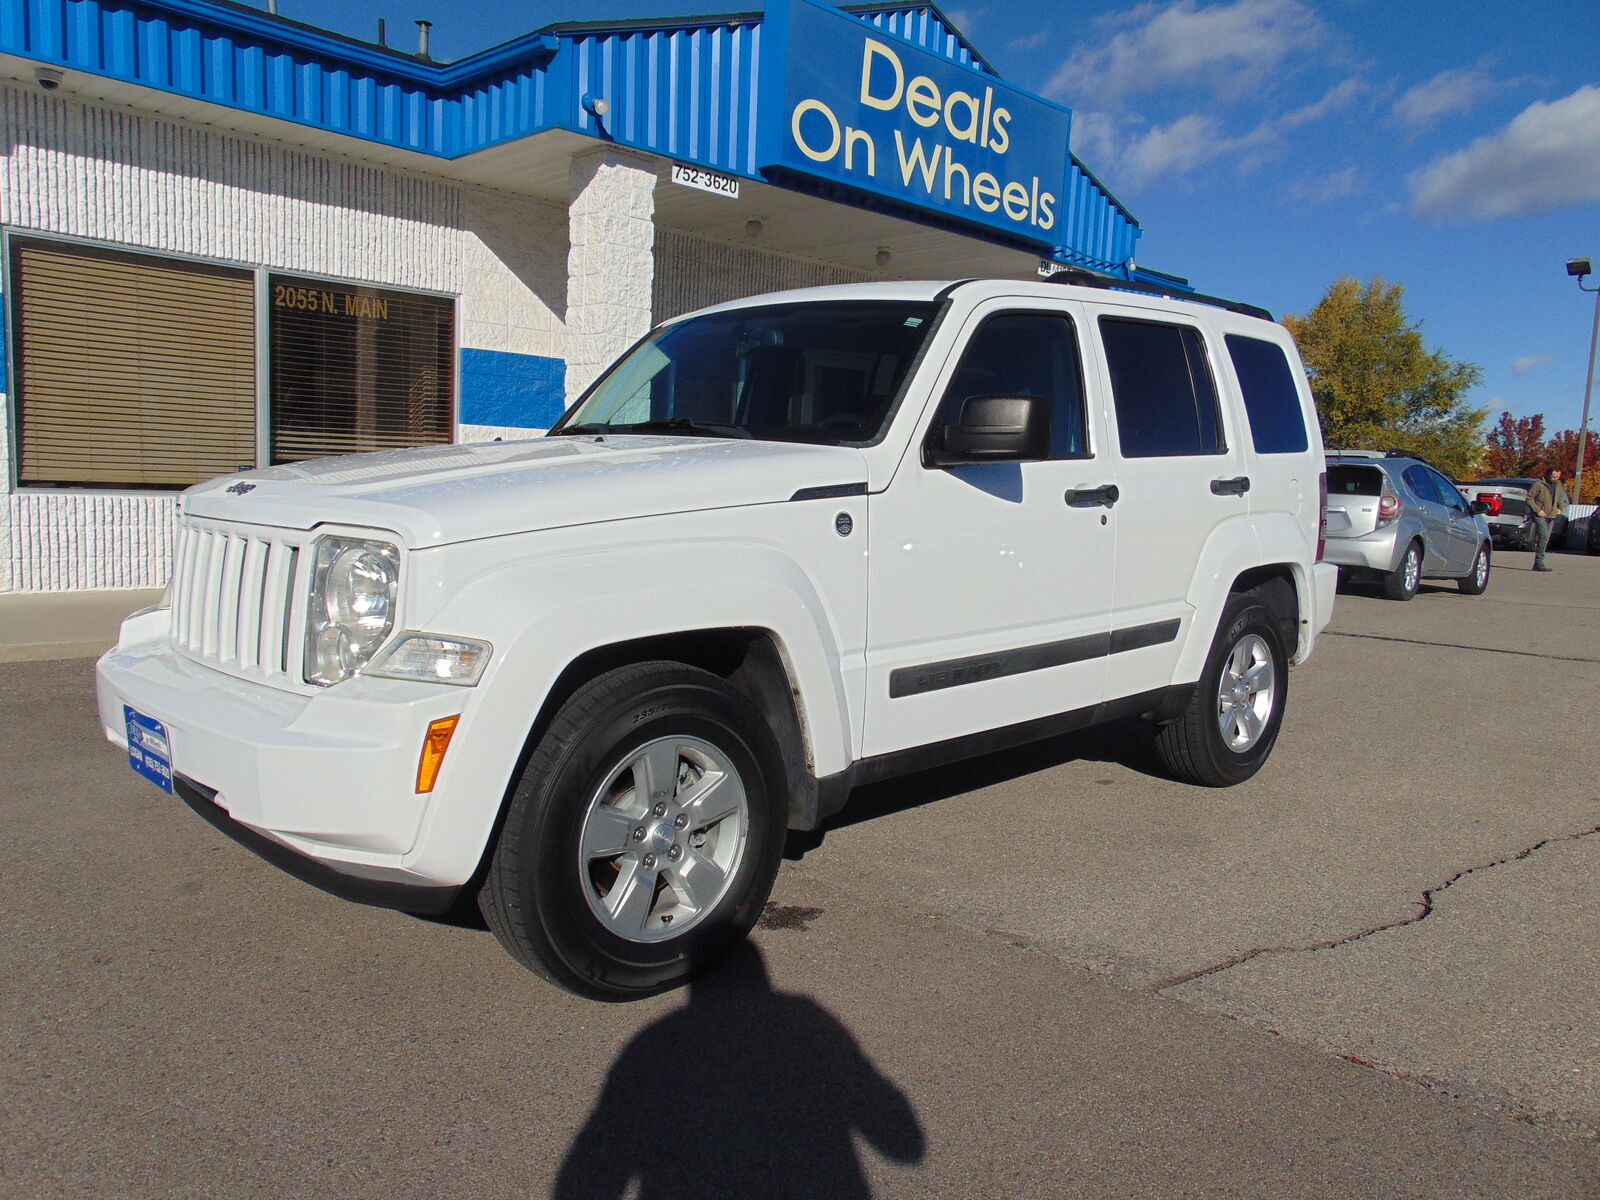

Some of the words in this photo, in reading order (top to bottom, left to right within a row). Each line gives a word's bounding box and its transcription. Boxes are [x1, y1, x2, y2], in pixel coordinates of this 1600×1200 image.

[860, 37, 1012, 154] Deals
[674, 163, 737, 194] 752-3620
[792, 98, 875, 177] On
[894, 129, 1056, 230] Wheels
[275, 285, 318, 311] 2055
[321, 291, 338, 315] N.
[345, 294, 388, 320] MAIN
